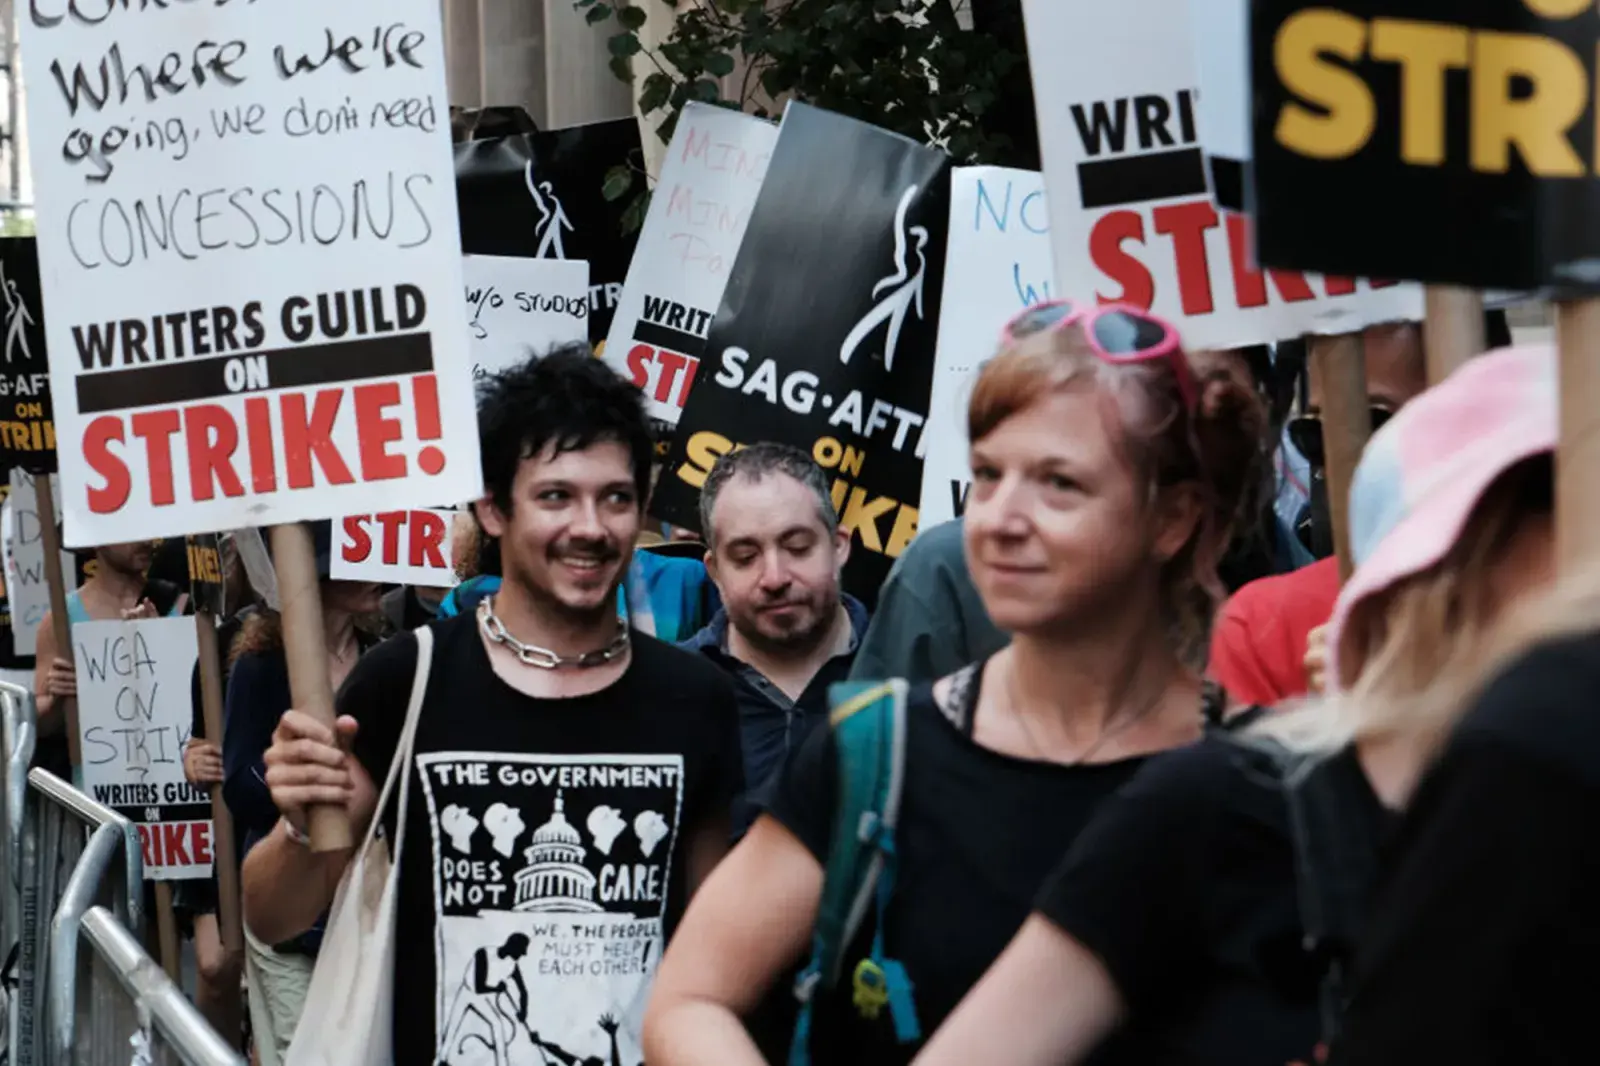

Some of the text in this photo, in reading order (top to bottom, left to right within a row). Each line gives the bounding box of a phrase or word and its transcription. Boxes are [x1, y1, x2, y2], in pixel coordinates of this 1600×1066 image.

[50, 23, 426, 117] Where we're
[1273, 6, 1600, 179] STR
[211, 104, 266, 138] we
[371, 96, 436, 133] need
[67, 172, 432, 268] CONCESSIONS
[71, 283, 427, 369] WRITERS GUILD
[224, 354, 270, 392] ON
[15, 402, 42, 418] ON
[82, 374, 446, 514] STRIKE!
[812, 436, 865, 478] ON
[80, 632, 157, 683] WGA
[115, 682, 158, 722] ON
[94, 782, 159, 804] WRITERS
[434, 764, 490, 786] THE
[145, 805, 160, 822] ON
[443, 858, 503, 881] DOES
[444, 882, 506, 906] NOT
[543, 940, 642, 957] MUST HELP
[571, 923, 606, 939] THE
[538, 958, 585, 975] EACH
